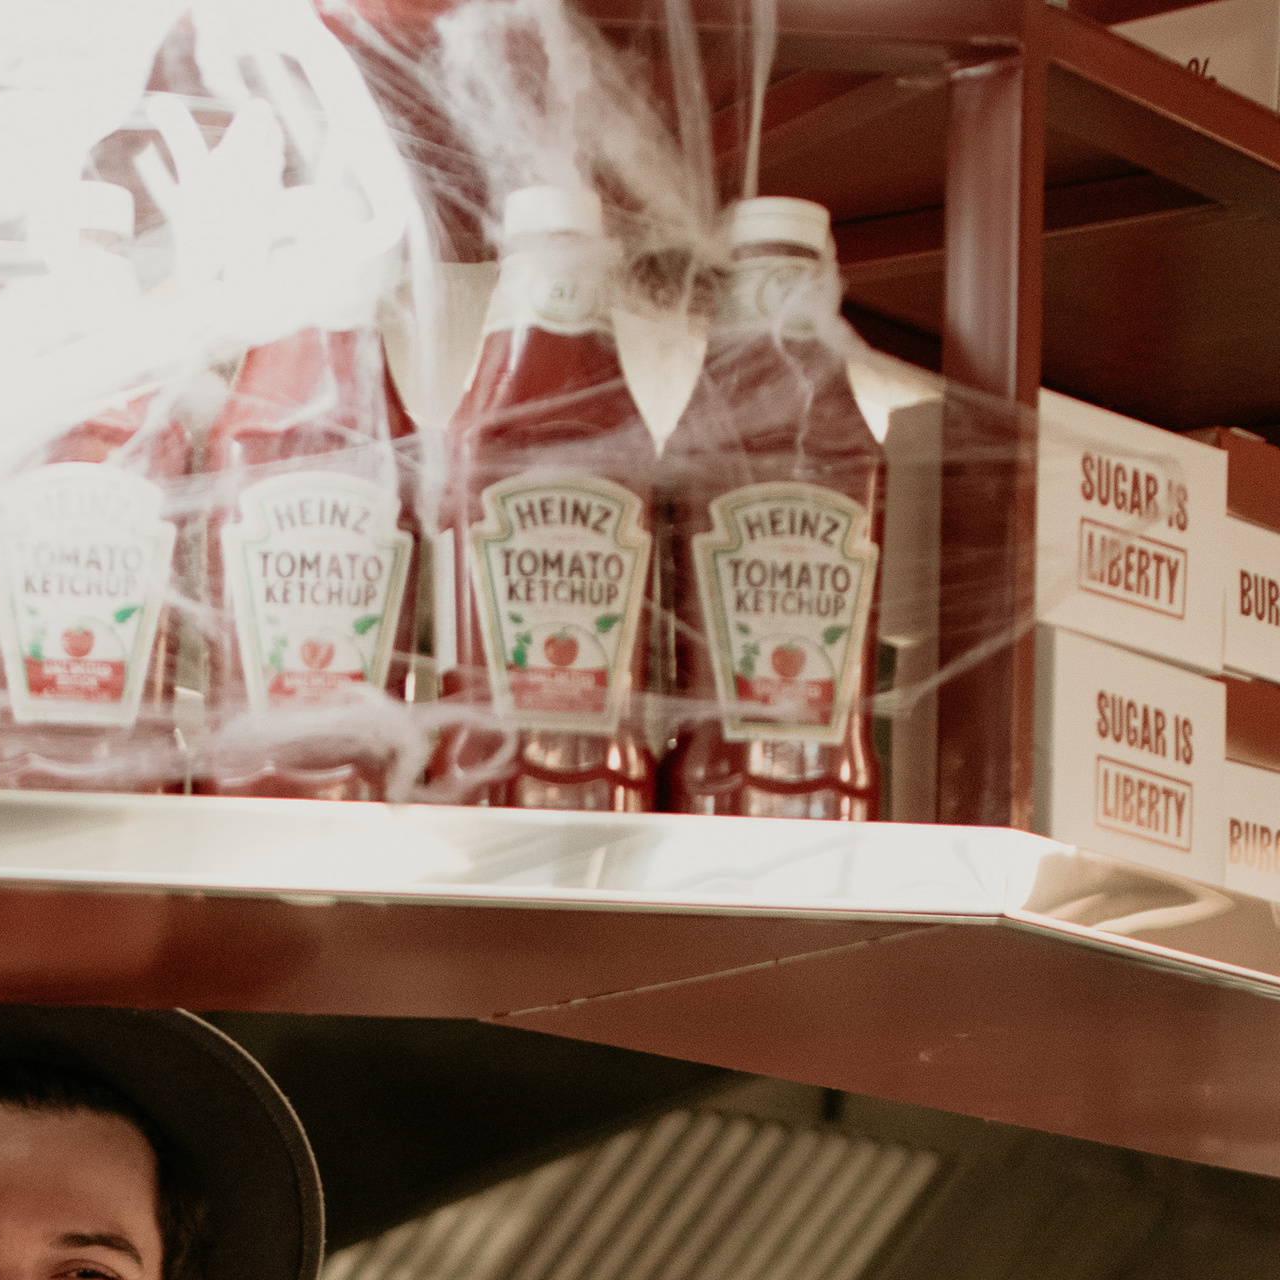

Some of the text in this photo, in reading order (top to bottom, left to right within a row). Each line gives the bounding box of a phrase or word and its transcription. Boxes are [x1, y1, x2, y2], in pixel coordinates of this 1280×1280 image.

[1080, 453, 1189, 532] SUGAR IS
[273, 497, 371, 535] HEINZ
[514, 496, 612, 536] HEINZ
[745, 507, 840, 546] HEINZ
[258, 551, 384, 582] TOMATO
[501, 549, 625, 582] TOMATO
[728, 558, 852, 592] TOMATO
[1087, 530, 1180, 605] LIBERTY
[23, 571, 138, 597] KETCHUP
[265, 579, 378, 607] KETCHUP
[507, 578, 619, 605] KETCHUP
[735, 588, 846, 617] KETCHUP
[1096, 689, 1194, 766] SUGAR IS
[1102, 768, 1186, 838] LIBERTY
